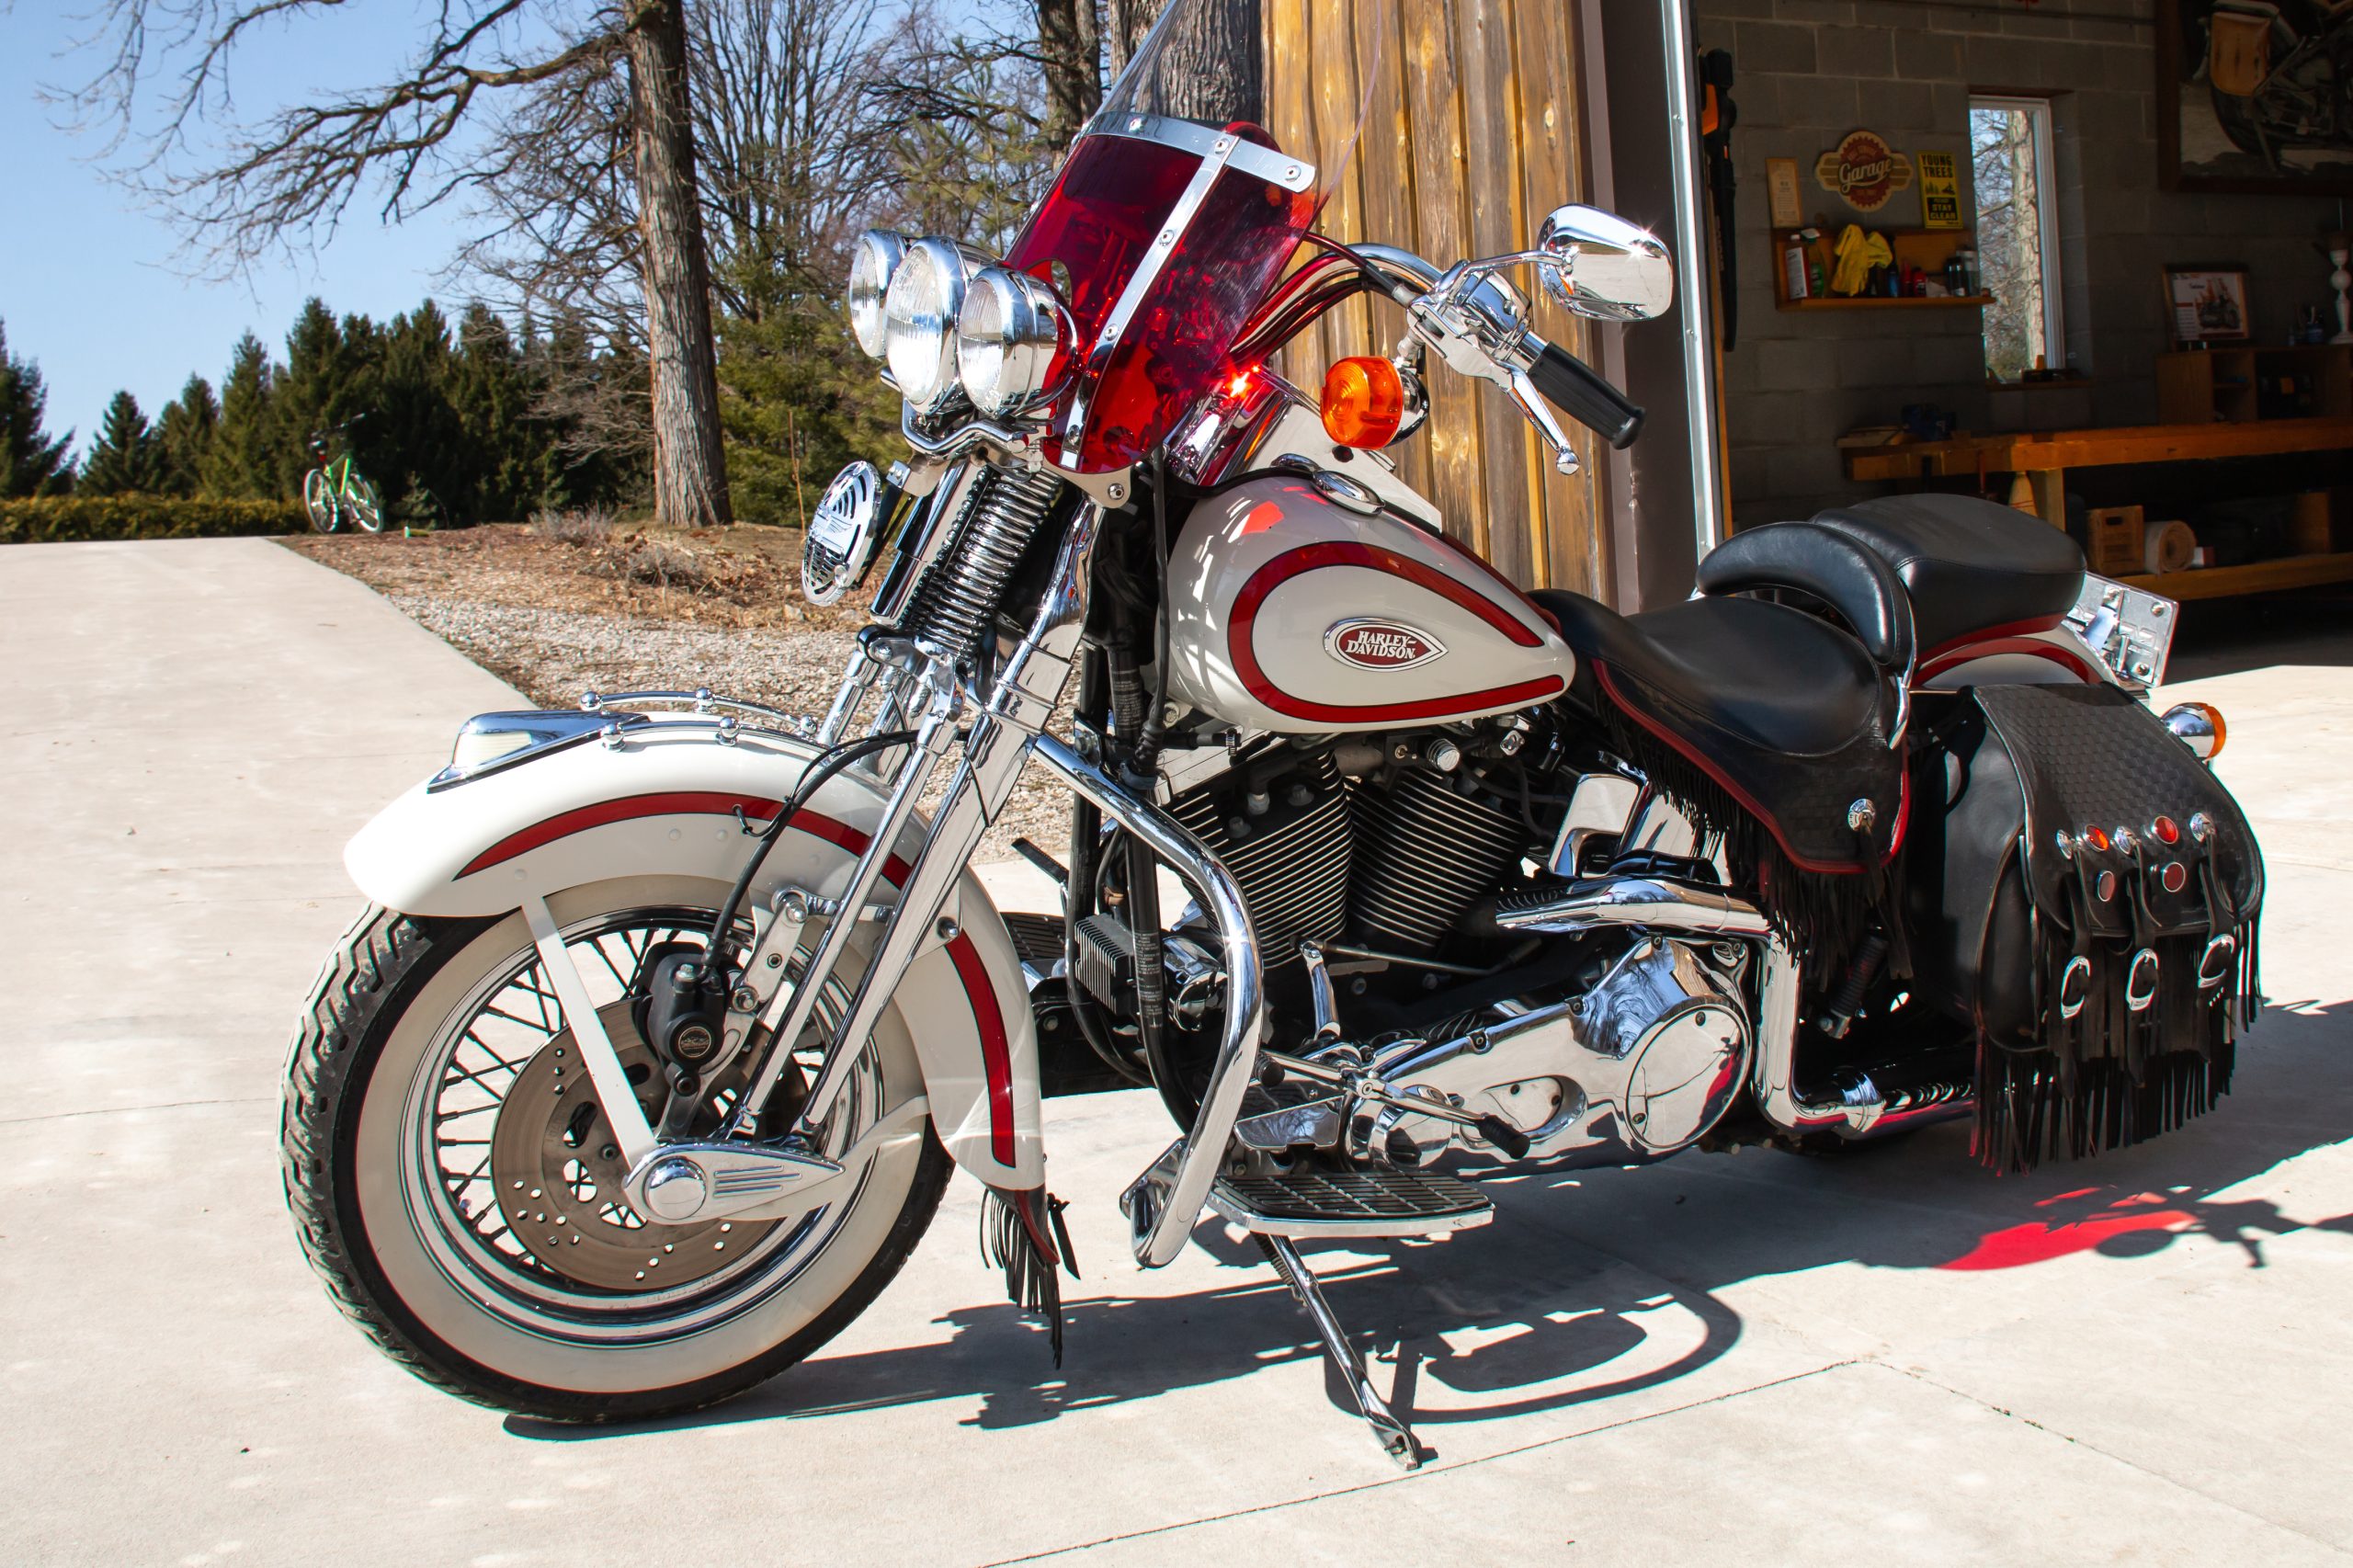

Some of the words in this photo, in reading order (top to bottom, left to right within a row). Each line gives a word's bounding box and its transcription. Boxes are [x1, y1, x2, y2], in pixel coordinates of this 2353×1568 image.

[1921, 154, 1952, 165] YOUNG
[1839, 158, 1892, 193] Garage
[1923, 166, 1954, 177] TREES
